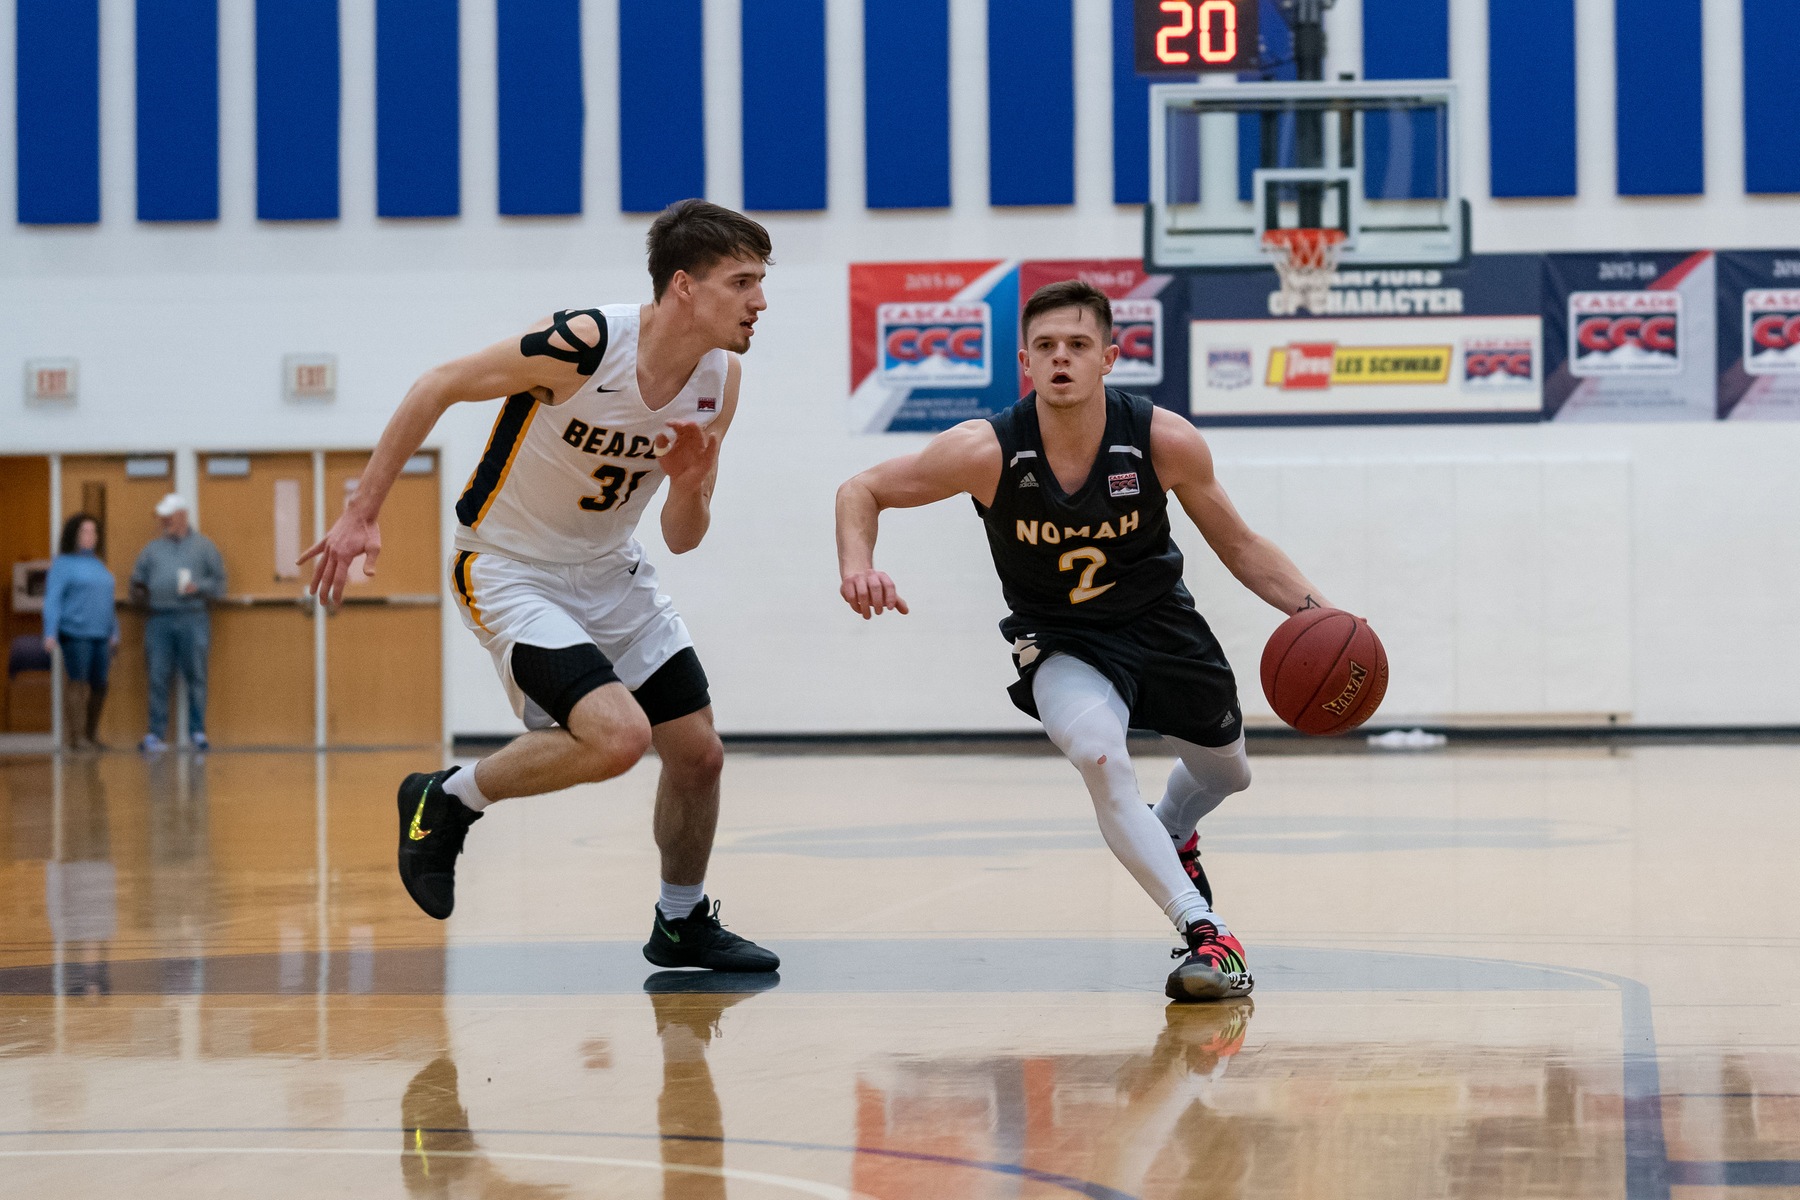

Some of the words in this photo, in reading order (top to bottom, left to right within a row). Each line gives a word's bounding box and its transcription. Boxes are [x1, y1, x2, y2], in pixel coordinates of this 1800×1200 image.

[1156, 0, 1238, 64] 20
[883, 304, 983, 321] CASCADE
[1307, 288, 1464, 315] CHARACTER
[1573, 294, 1677, 309] CASCADE
[886, 327, 983, 360] CCC
[1578, 316, 1677, 351] CCC
[1336, 357, 1363, 375] LES
[1369, 356, 1442, 374] SCHWAB
[1466, 353, 1531, 377] CCC
[578, 464, 654, 513] 31
[1109, 473, 1137, 481] CASCADE
[1111, 479, 1137, 490] CCC
[1016, 510, 1139, 545] NOMAH
[1059, 546, 1117, 605] 2
[1321, 660, 1368, 715] NAIA
